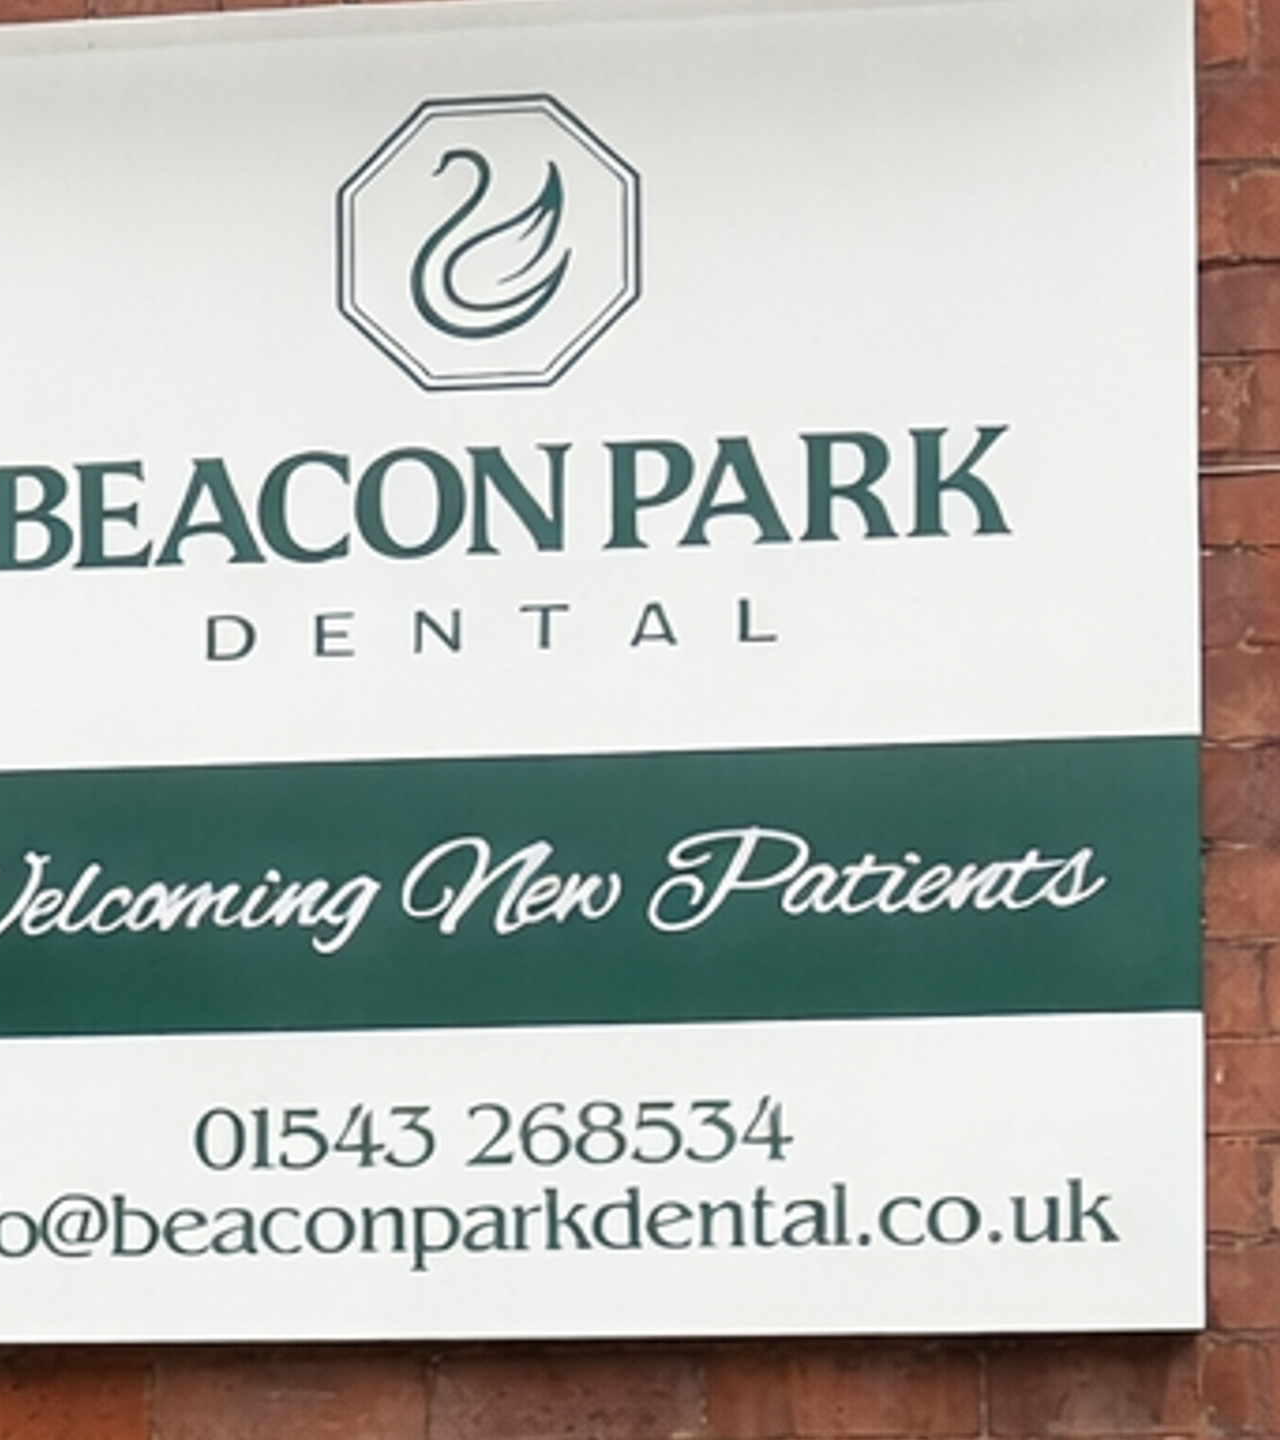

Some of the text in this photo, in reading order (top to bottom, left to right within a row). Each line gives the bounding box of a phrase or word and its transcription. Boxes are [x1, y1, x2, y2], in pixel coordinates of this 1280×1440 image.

[603, 425, 1011, 549] PARK
[206, 599, 776, 660] DENTAL
[402, 837, 621, 934] New
[648, 827, 1105, 931] Patients
[194, 1096, 794, 1171] 01543 268534
